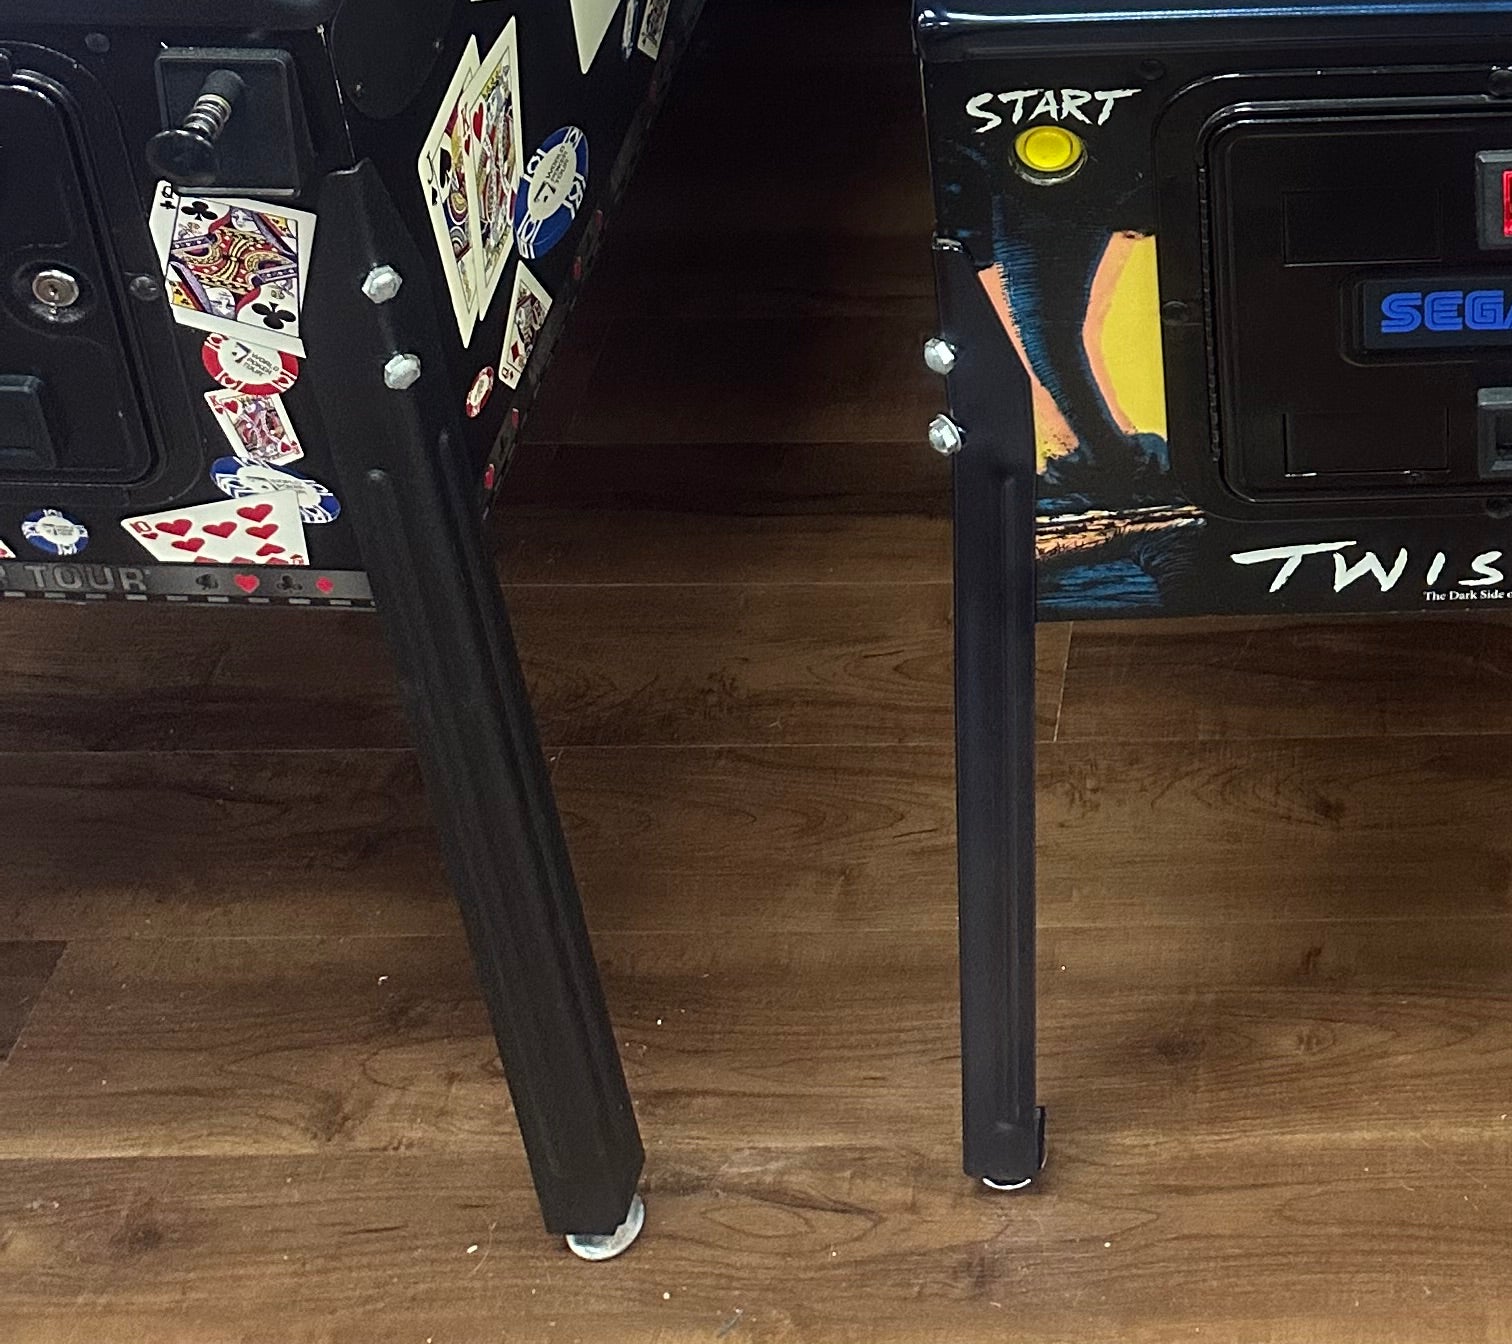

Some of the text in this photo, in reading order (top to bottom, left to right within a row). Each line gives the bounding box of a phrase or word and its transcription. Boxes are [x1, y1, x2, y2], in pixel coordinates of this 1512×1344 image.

[965, 88, 1141, 133] START
[24, 564, 148, 591] TOUR
[1423, 589, 1446, 601] The
[1449, 589, 1478, 601] Dark
[1480, 588, 1504, 600] Side
